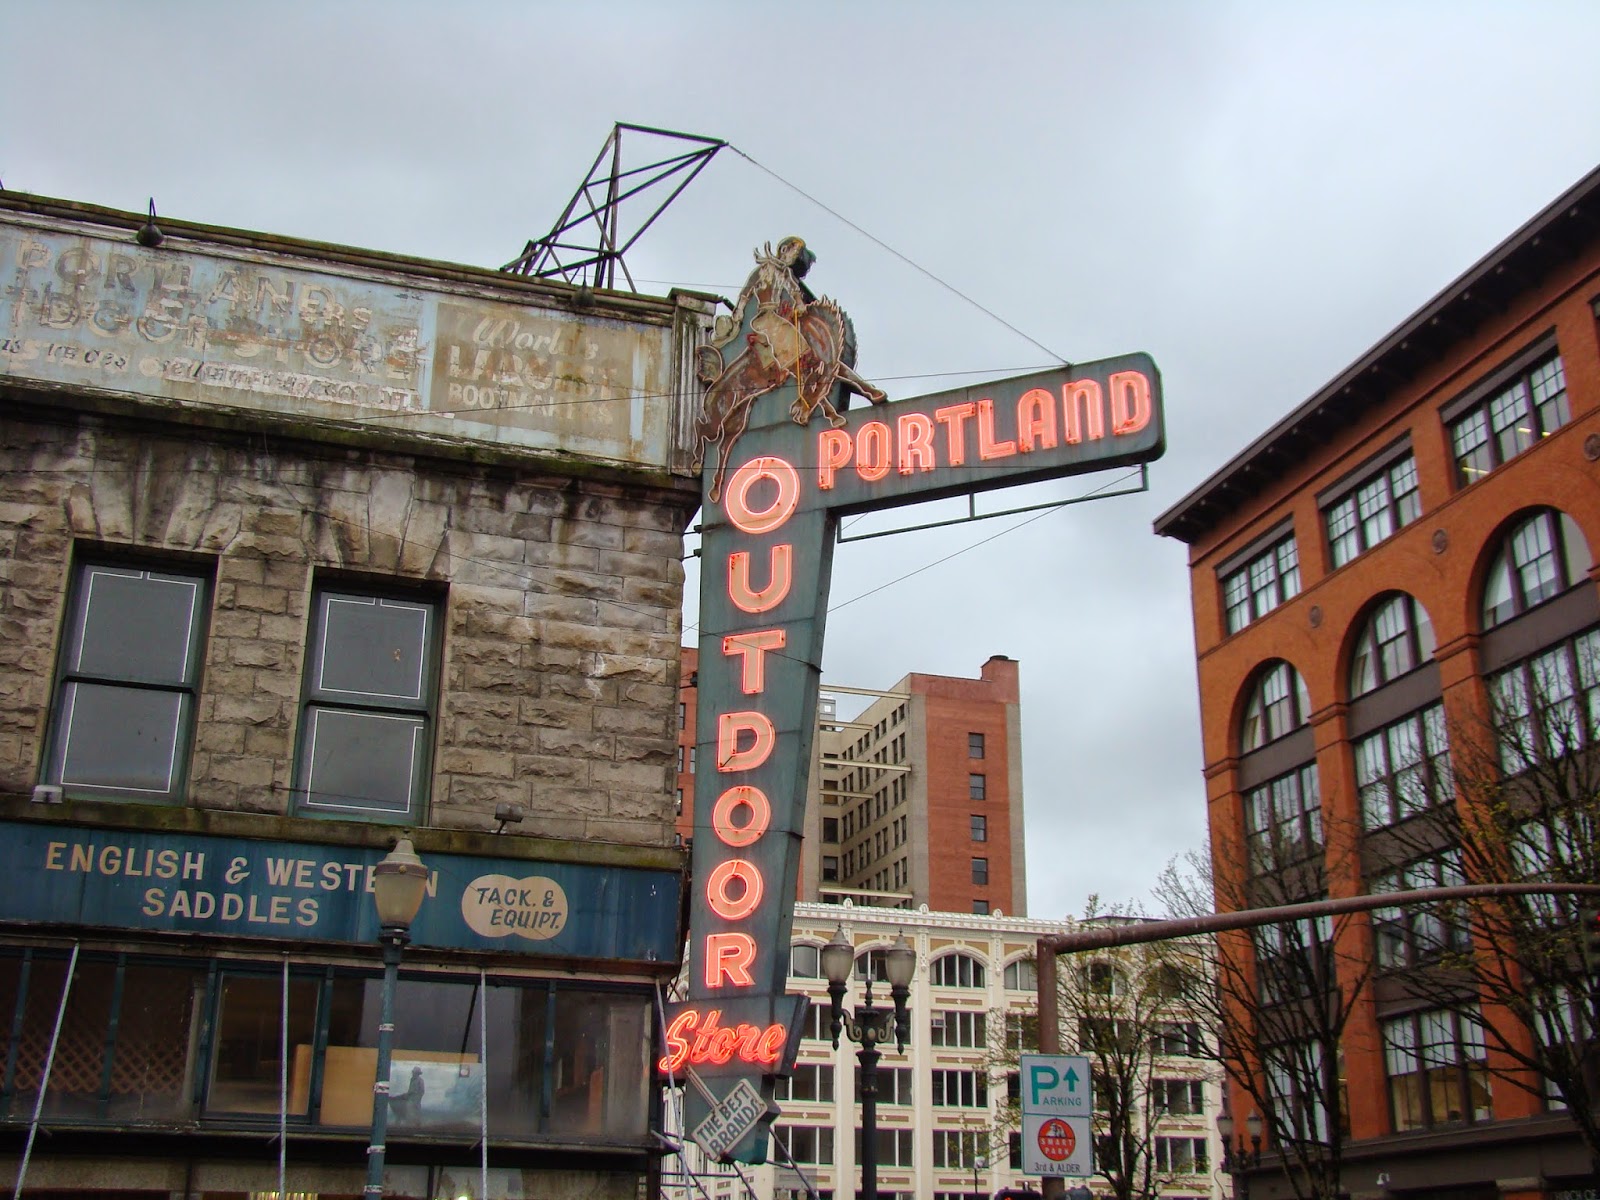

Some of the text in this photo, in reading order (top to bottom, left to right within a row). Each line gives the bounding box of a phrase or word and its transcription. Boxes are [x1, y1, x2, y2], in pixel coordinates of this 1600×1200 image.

[818, 369, 1152, 491] PORTLAND
[705, 455, 801, 990] OUTDOOR
[45, 842, 439, 899] ENGLISH & WESTEN
[142, 888, 320, 927] SADDLES
[490, 907, 560, 930] EQUIPT.
[543, 889, 555, 908] &
[658, 1009, 787, 1073] Store
[696, 1083, 750, 1142] THE BEST
[708, 1098, 760, 1156] BRANDS
[1040, 1136, 1073, 1147] SMART
[1044, 1146, 1070, 1156] PARK
[1034, 1161, 1081, 1174] 3rd & ALDER
